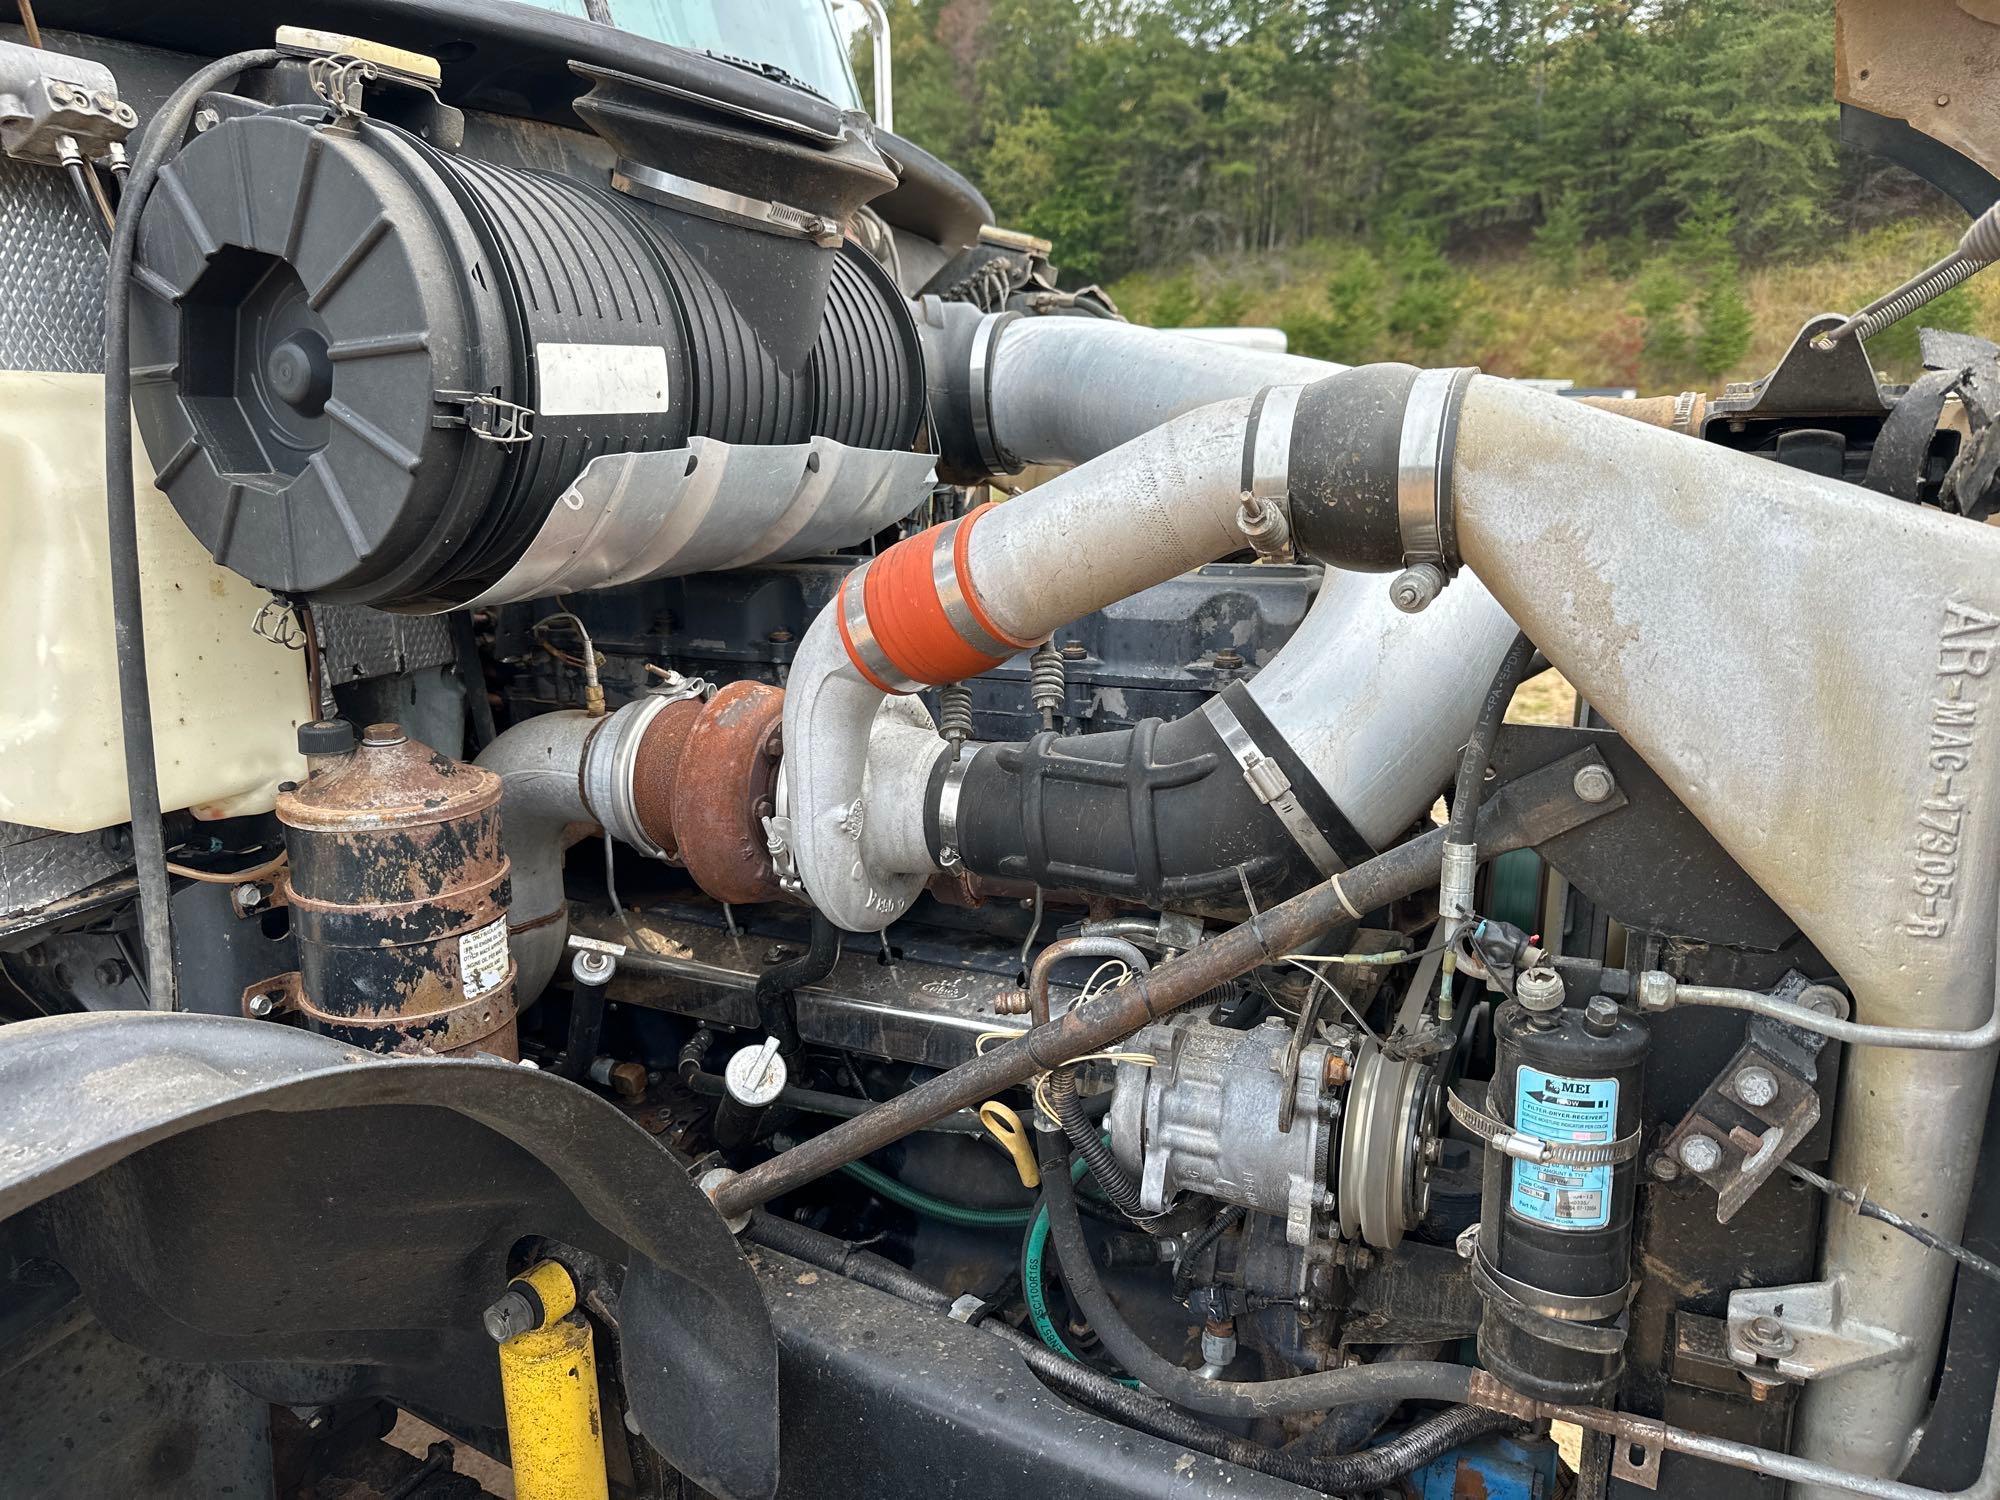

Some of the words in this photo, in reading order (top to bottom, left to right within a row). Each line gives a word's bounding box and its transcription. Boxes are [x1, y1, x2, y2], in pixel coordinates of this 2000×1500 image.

[1561, 1081, 1591, 1094] MEI
[1537, 1115, 1560, 1126] MOISTURE
[1520, 1177, 1533, 1187] Date
[1518, 1199, 1530, 1209] Part
